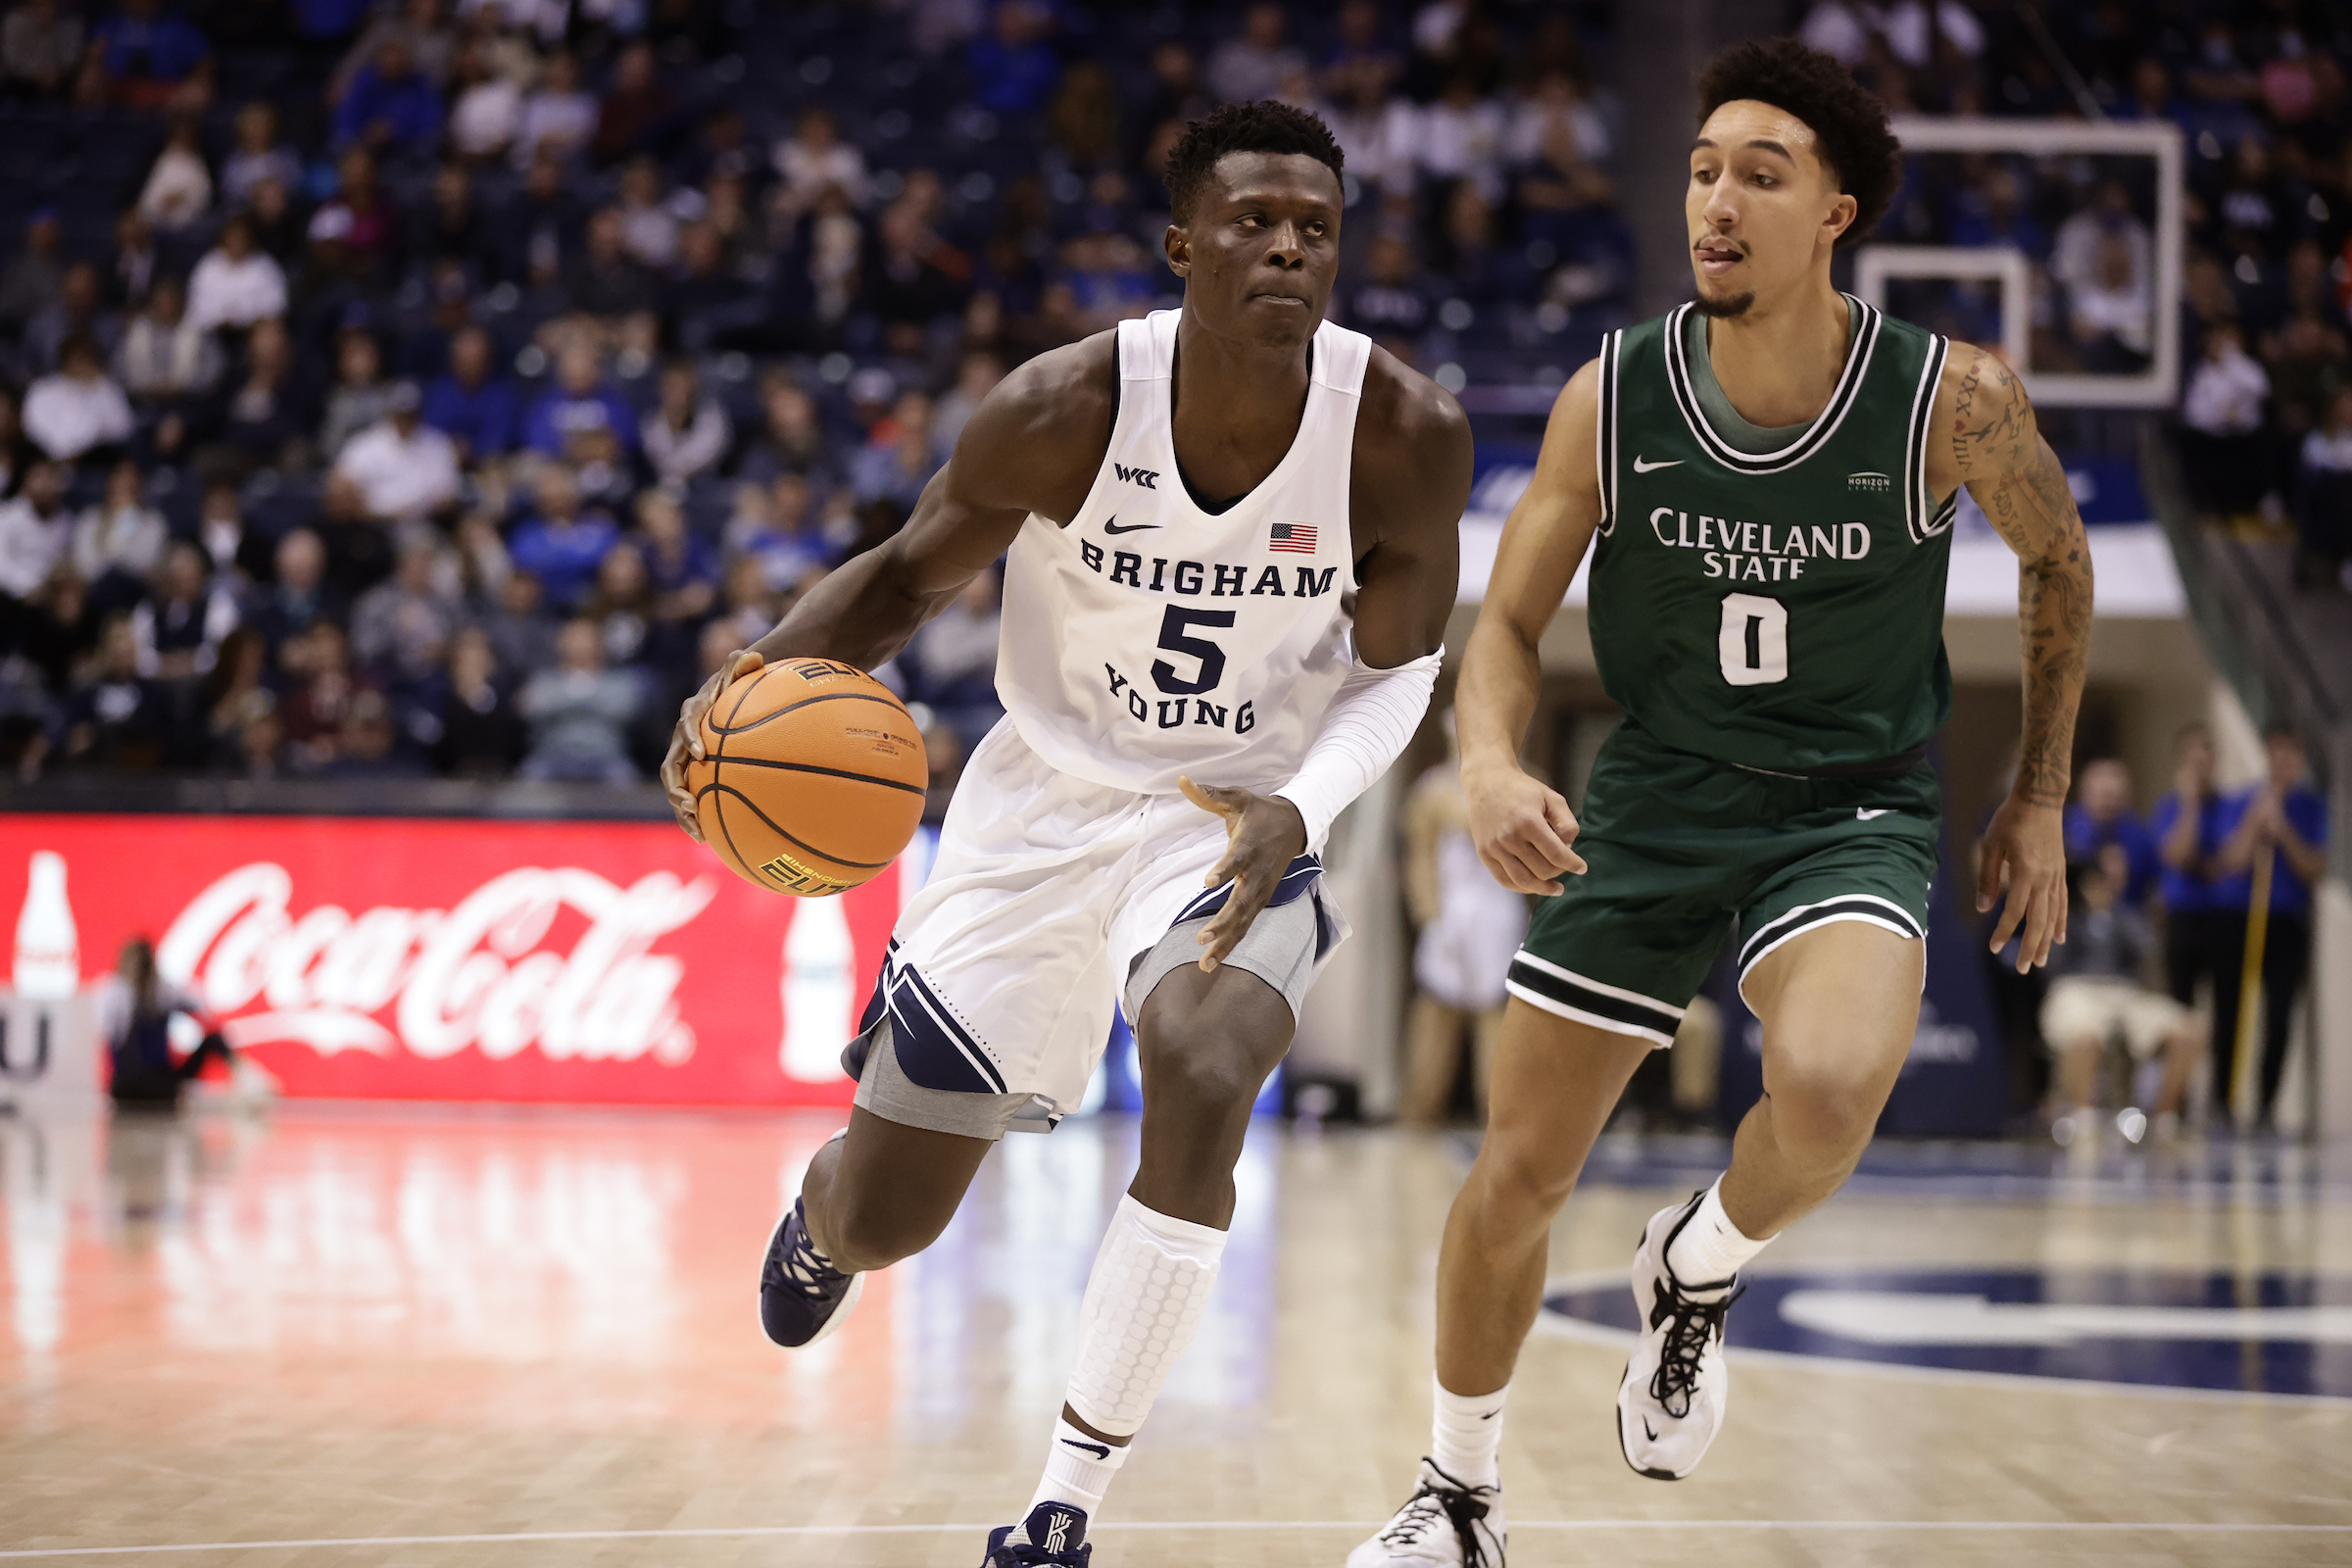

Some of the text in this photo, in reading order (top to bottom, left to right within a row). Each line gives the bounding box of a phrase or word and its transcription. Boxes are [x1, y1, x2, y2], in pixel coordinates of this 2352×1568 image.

[1114, 463, 1160, 490] WCC
[1847, 477, 1890, 486] HORIZON
[1649, 507, 1871, 560] CLEVELAND
[1081, 538, 1338, 598] BRIGHAM
[1703, 551, 1805, 582] STATE
[1151, 603, 1237, 695] 5
[1719, 592, 1788, 686] 0
[1104, 662, 1254, 734] YOUNG
[758, 857, 866, 896] LITE
